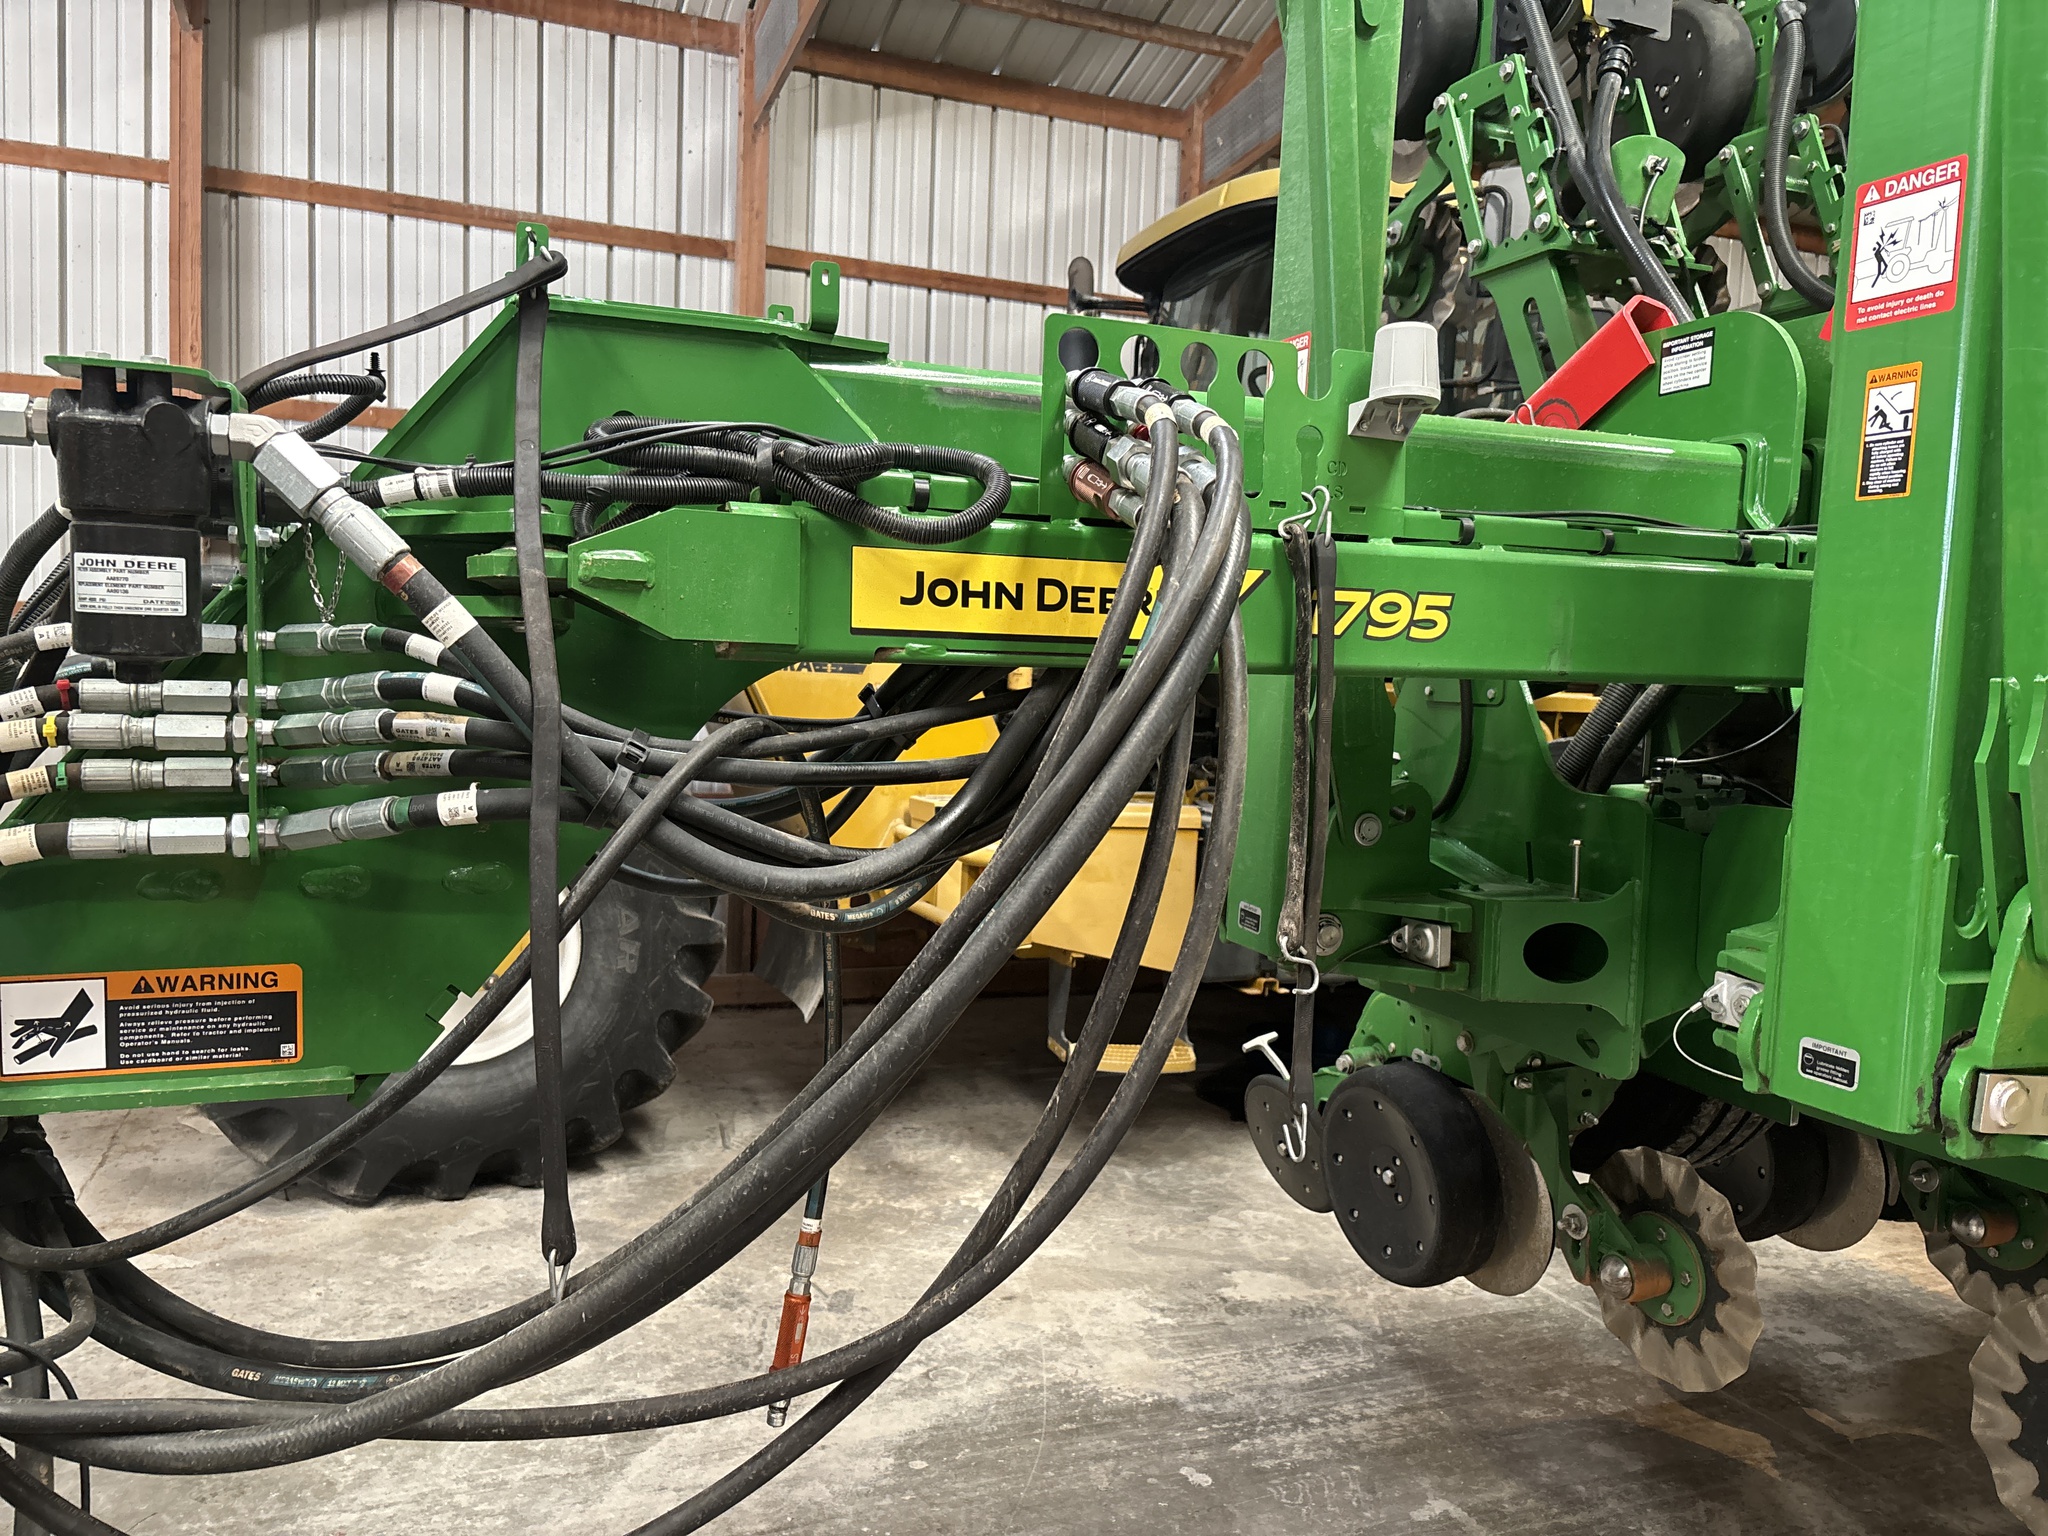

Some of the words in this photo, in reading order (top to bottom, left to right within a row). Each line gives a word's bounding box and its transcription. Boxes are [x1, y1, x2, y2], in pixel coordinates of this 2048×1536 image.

[1885, 161, 1960, 198] DANGER
[1867, 303, 1884, 312] avoid
[1886, 300, 1904, 308] injury
[1915, 292, 1933, 300] death
[1857, 316, 1867, 324] not
[1869, 311, 1892, 321] contact
[1894, 306, 1918, 315] electric
[1920, 302, 1936, 310] lines
[1663, 337, 1689, 348] IMPORTANT
[1690, 331, 1713, 341] STORAGE
[1671, 341, 1703, 353] INFORMATION
[1878, 369, 1918, 382] WARNING
[80, 558, 116, 567] JOHN
[124, 560, 177, 570] DEERE
[900, 571, 1023, 610] JOHN
[1037, 578, 1152, 616] DEER
[1313, 588, 1454, 642] 795
[156, 971, 278, 993] WARNING
[119, 1010, 162, 1018] pressurized
[1812, 1042, 1847, 1057] IMPORTANT
[231, 1368, 262, 1381] GATES
